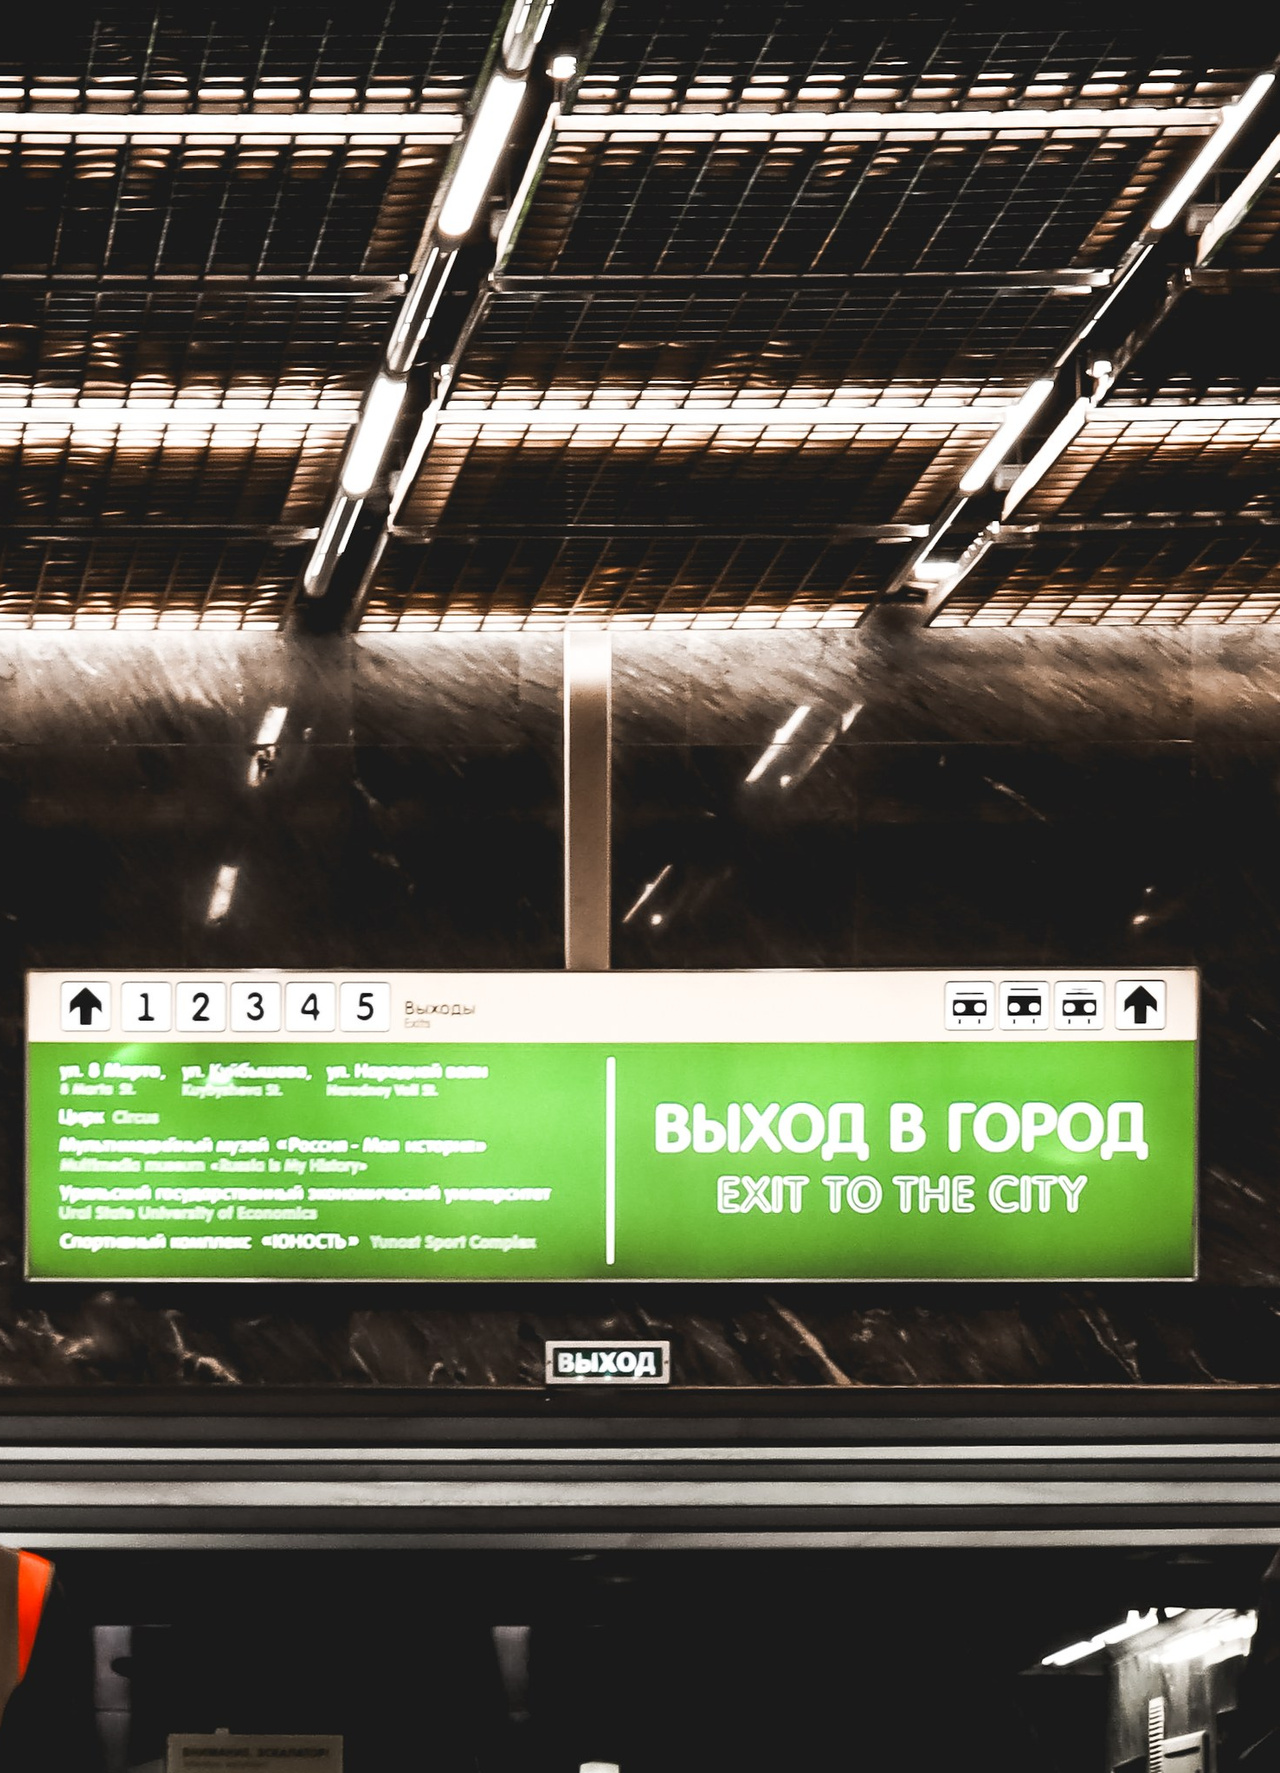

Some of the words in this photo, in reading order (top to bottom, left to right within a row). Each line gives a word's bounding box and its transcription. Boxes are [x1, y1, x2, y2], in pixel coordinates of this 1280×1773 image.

[138, 991, 155, 1022] 1
[192, 991, 211, 1022] 2
[247, 991, 265, 1022] 3
[300, 991, 320, 1022] 4
[357, 991, 375, 1022] 5
[405, 1000, 476, 1016] Выходы
[58, 1108, 105, 1127] Цирк
[654, 1101, 870, 1162] ВЫХОД
[889, 1102, 927, 1154] В
[948, 1101, 1150, 1162] ГОРОД
[216, 1137, 270, 1156] музей
[716, 1175, 810, 1214] EXIT
[822, 1175, 883, 1214] TO
[892, 1175, 977, 1214] THE
[987, 1175, 1089, 1214] CITY
[59, 1206, 92, 1220] Ural
[95, 1206, 135, 1220] State
[138, 1206, 214, 1223] University
[217, 1206, 234, 1220] of
[59, 1233, 167, 1253] Спортивный
[261, 1233, 359, 1250] «ЮНОСТЬ»
[425, 1235, 467, 1252] Sport
[558, 1351, 657, 1377] ВЫХОД
